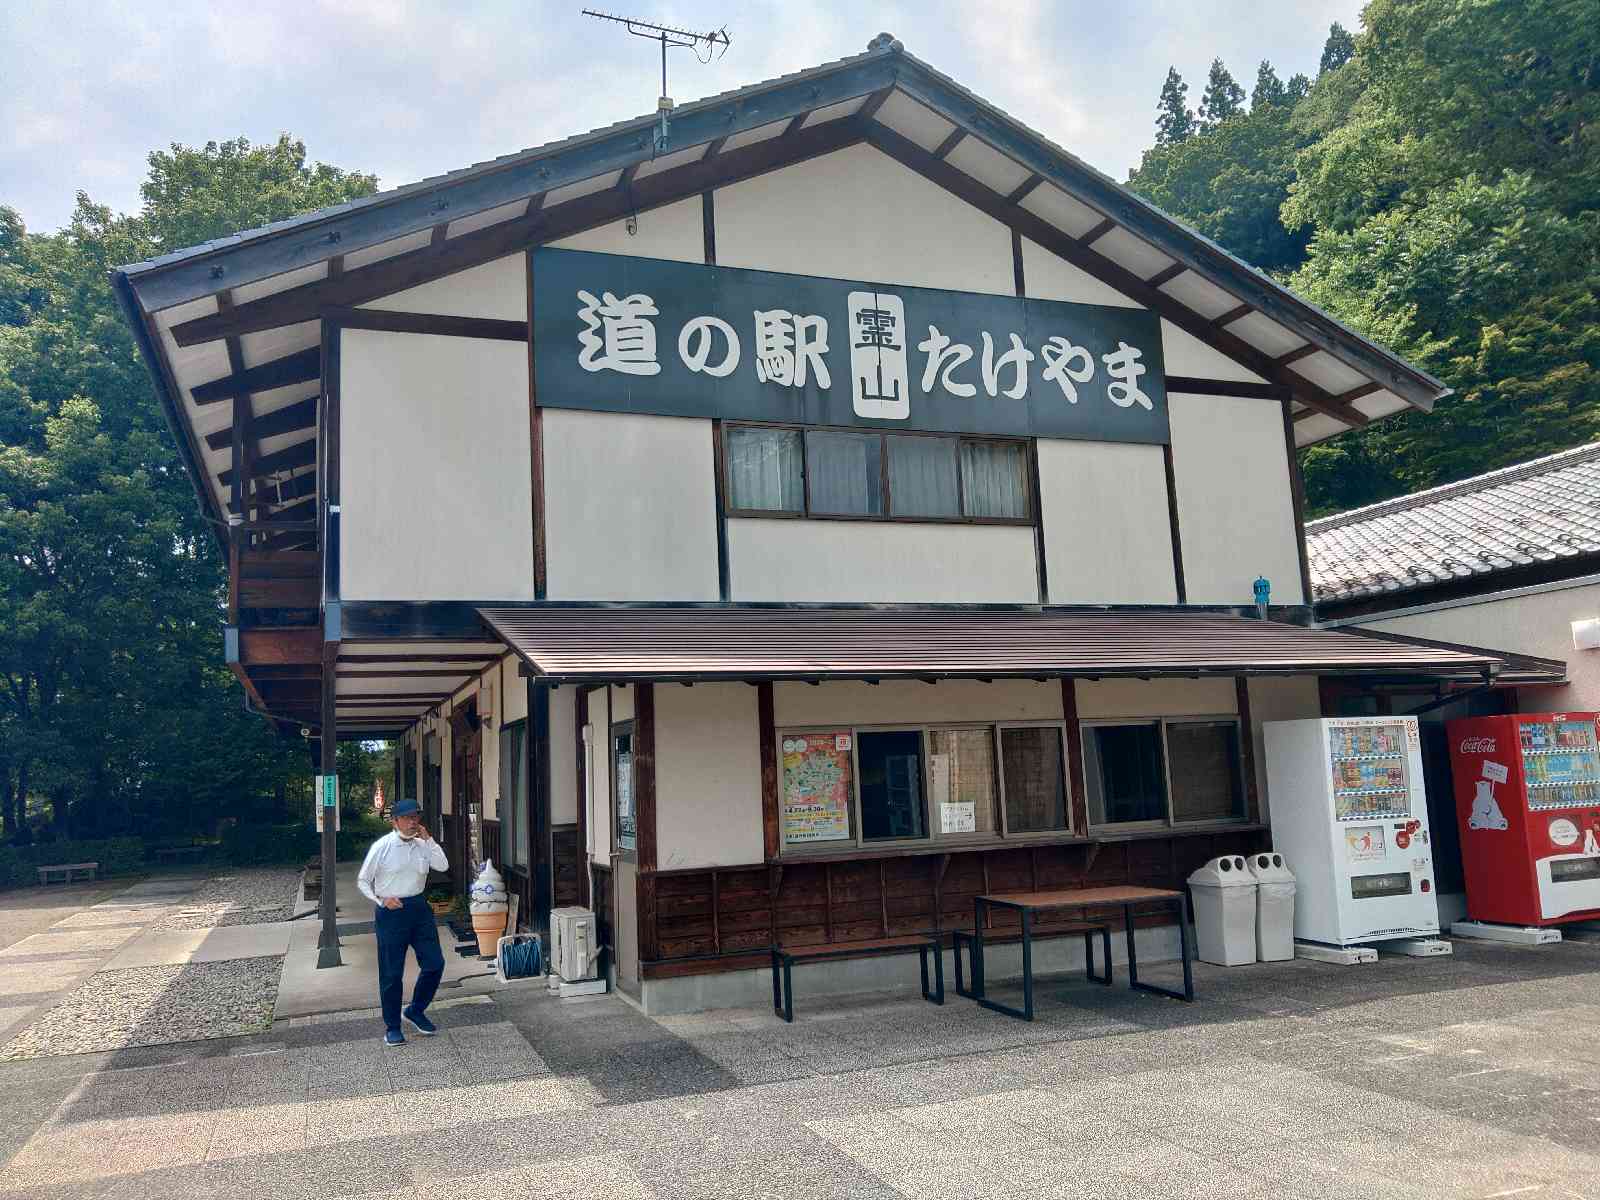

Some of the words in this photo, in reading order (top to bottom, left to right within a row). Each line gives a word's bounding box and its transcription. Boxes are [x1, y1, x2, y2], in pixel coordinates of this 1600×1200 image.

[577, 289, 831, 389] 道の駅
[917, 325, 1153, 410] たけやま
